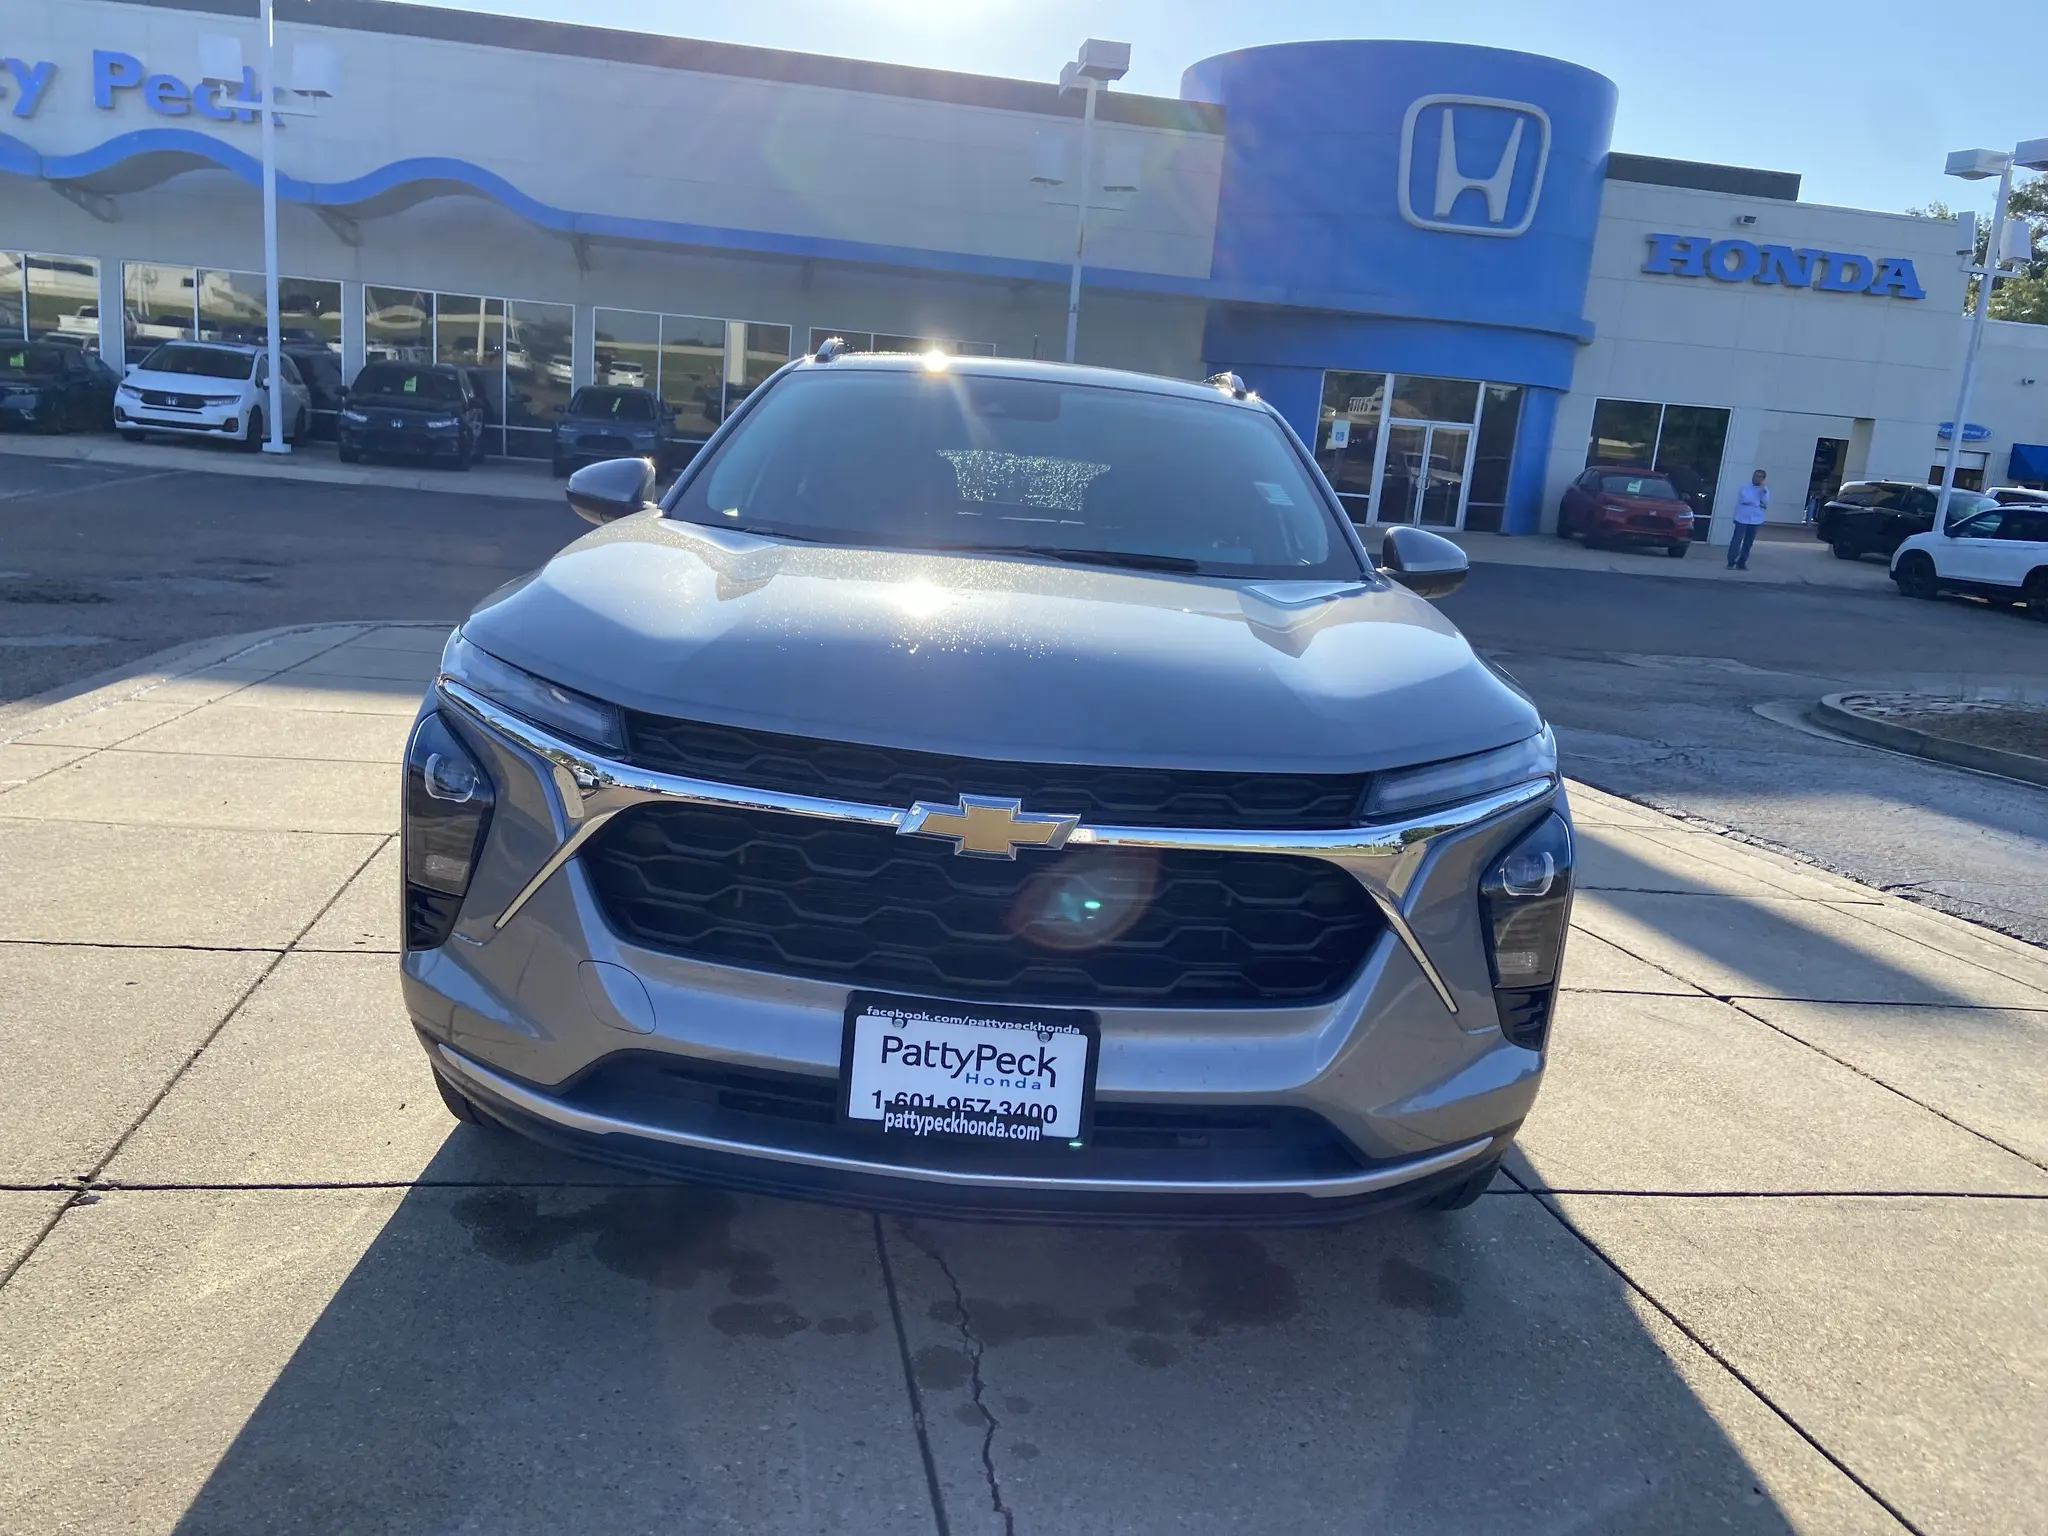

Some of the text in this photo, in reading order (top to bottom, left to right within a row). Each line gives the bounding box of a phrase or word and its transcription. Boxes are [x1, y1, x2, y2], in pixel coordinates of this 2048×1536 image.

[0, 56, 58, 118] y
[1641, 233, 1927, 300] HONDA
[866, 1005, 1080, 1035] facebook.com/pattypeckhonda
[881, 1035, 1057, 1088] PattyPeck
[965, 1072, 1041, 1090] Honda
[871, 1089, 1058, 1124] 1-601-957-3400
[884, 1110, 1041, 1141] pattypeckhonda.com
